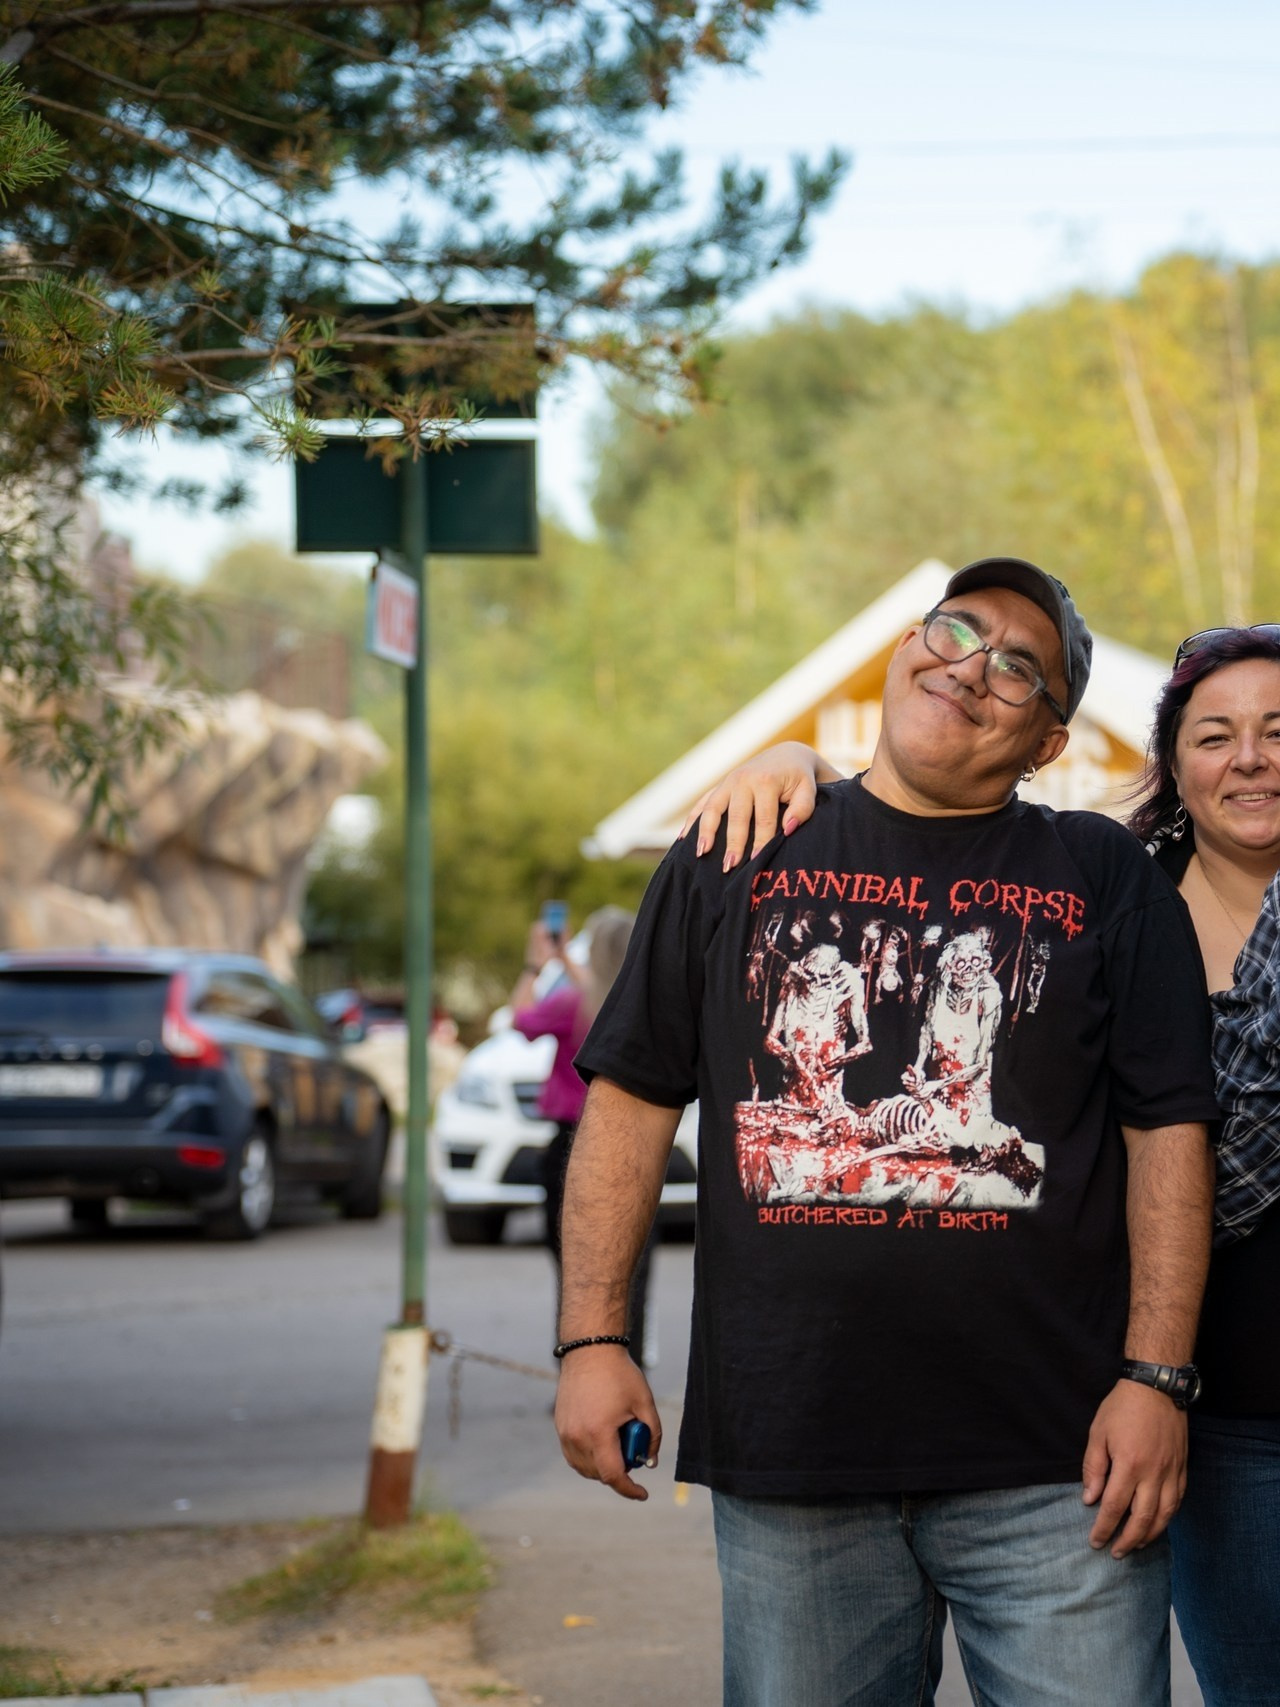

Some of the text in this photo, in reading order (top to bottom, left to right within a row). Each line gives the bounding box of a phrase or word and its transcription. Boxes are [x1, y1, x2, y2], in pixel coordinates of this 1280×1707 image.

[751, 868, 1085, 941] CANNIBAL CORPSE
[758, 1205, 1009, 1231] BUTCHERED AT BIRTH
